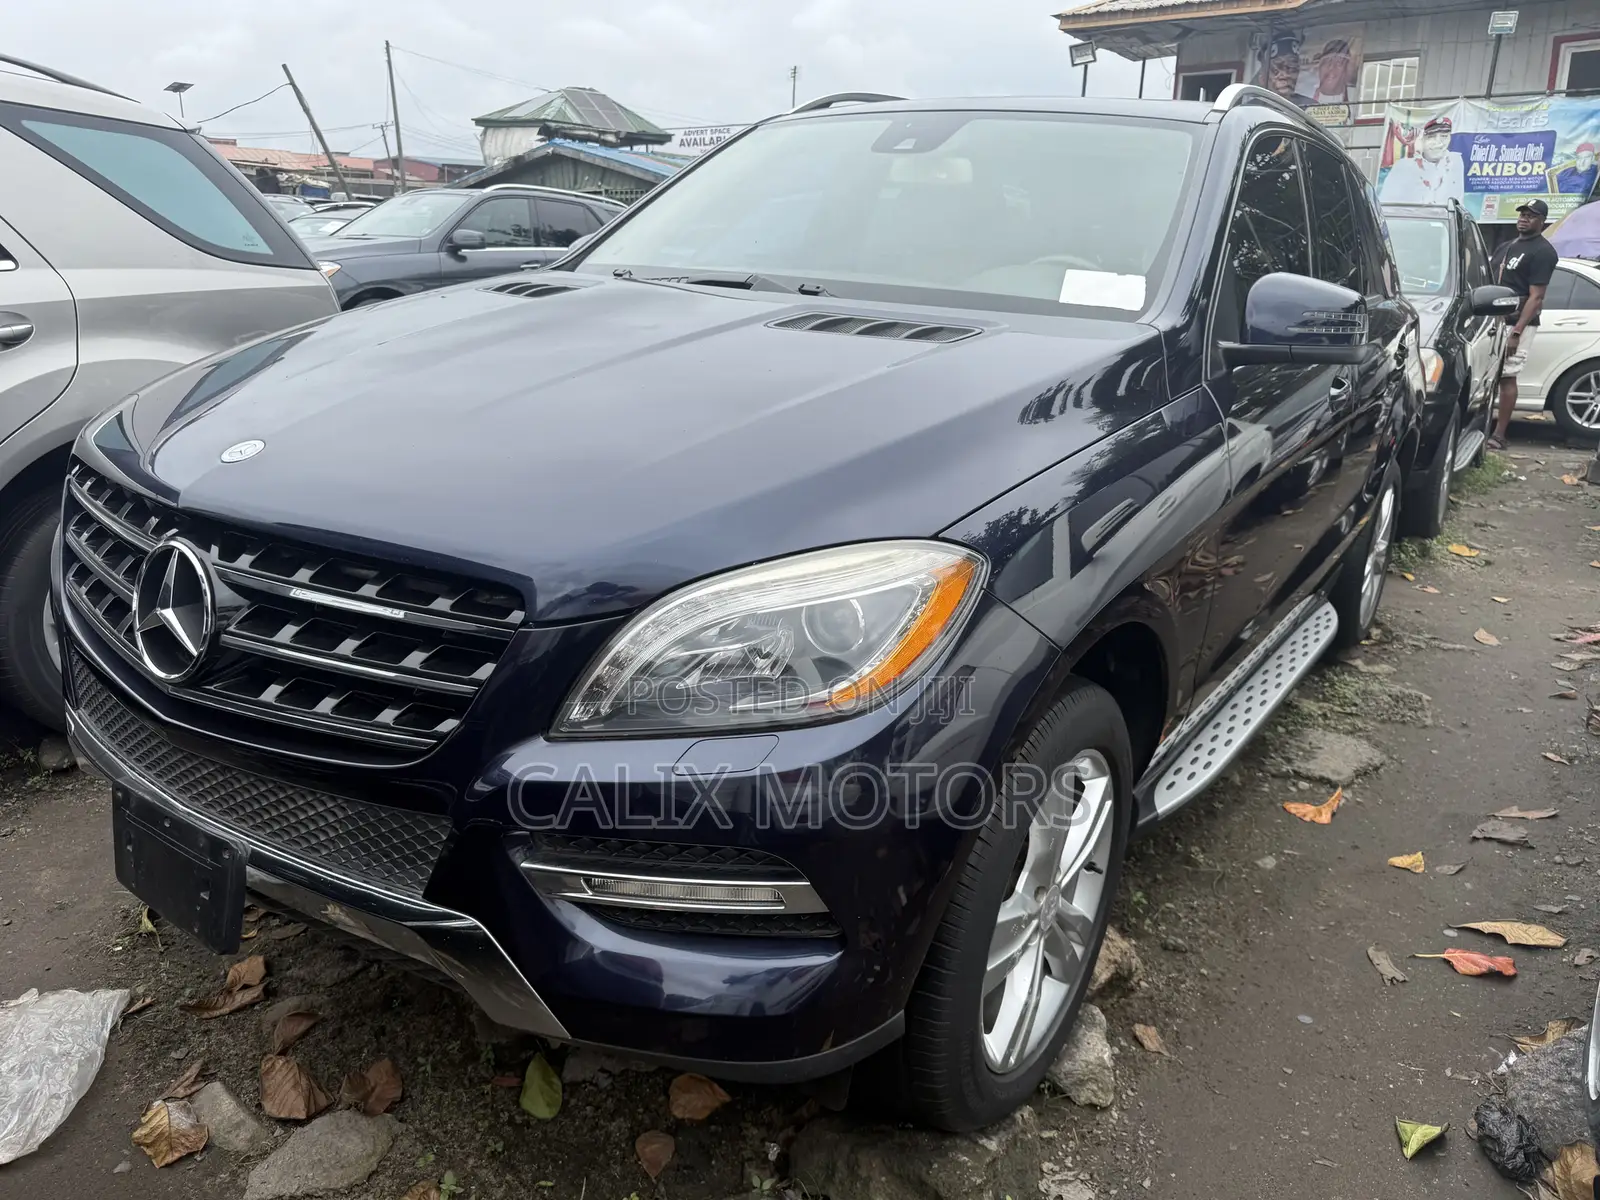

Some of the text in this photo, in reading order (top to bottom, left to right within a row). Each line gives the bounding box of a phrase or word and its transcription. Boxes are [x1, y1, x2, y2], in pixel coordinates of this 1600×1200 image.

[1470, 142, 1544, 164] Chief Dr. Sunday Okah
[1467, 161, 1546, 176] AKIBOR
